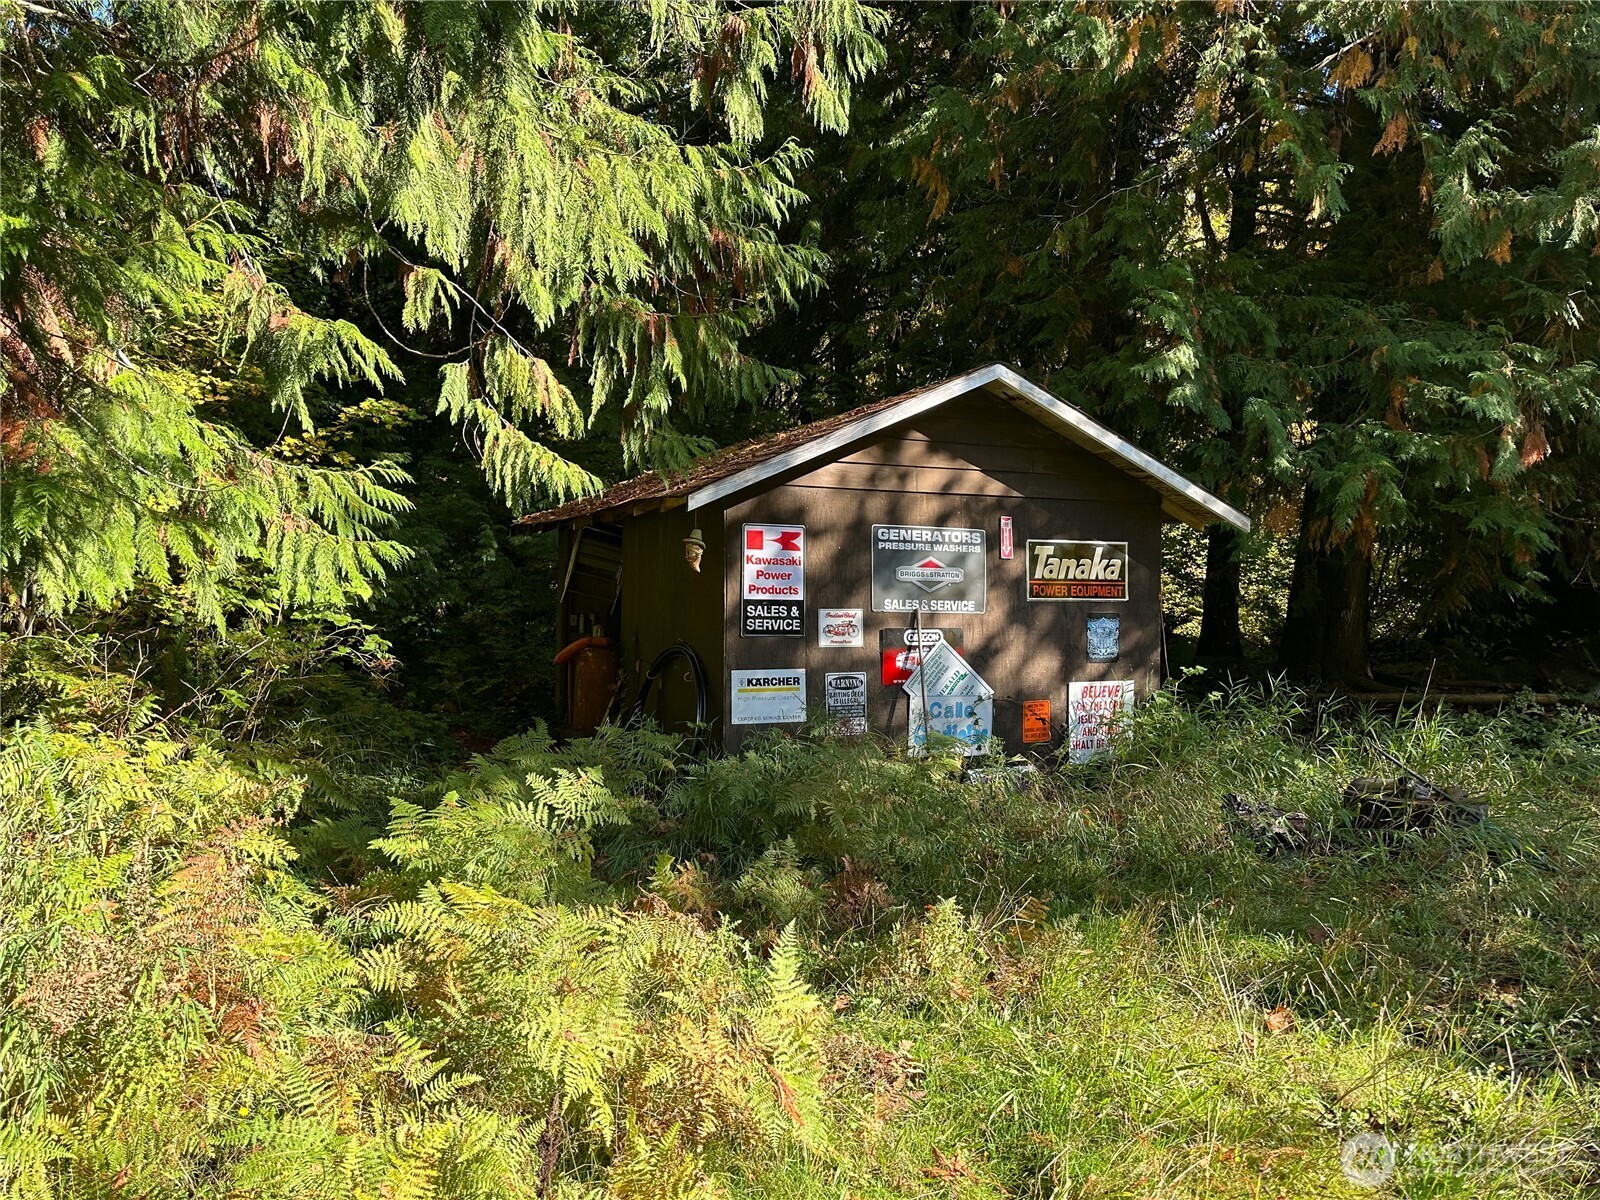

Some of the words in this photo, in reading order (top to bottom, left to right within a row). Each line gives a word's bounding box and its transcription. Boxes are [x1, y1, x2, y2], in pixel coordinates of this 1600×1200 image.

[878, 529, 981, 543] GENERATORS
[878, 542, 931, 551] PRESSURE
[933, 544, 980, 553] WASHERS
[746, 555, 801, 566] Kawasaki
[1034, 545, 1121, 580] Tanaka
[756, 570, 792, 580] Power
[748, 584, 799, 595] Products
[1033, 585, 1068, 596] POWER
[1071, 586, 1123, 597] EQUIPMENT
[746, 605, 787, 617] SALES
[790, 606, 799, 617] &
[884, 599, 919, 610] SALES
[921, 599, 929, 610] &
[931, 600, 975, 611] SERVICE
[746, 619, 800, 631] SERVICE
[747, 677, 800, 687] KÄRCHER
[1082, 685, 1120, 698] BELIEVE
